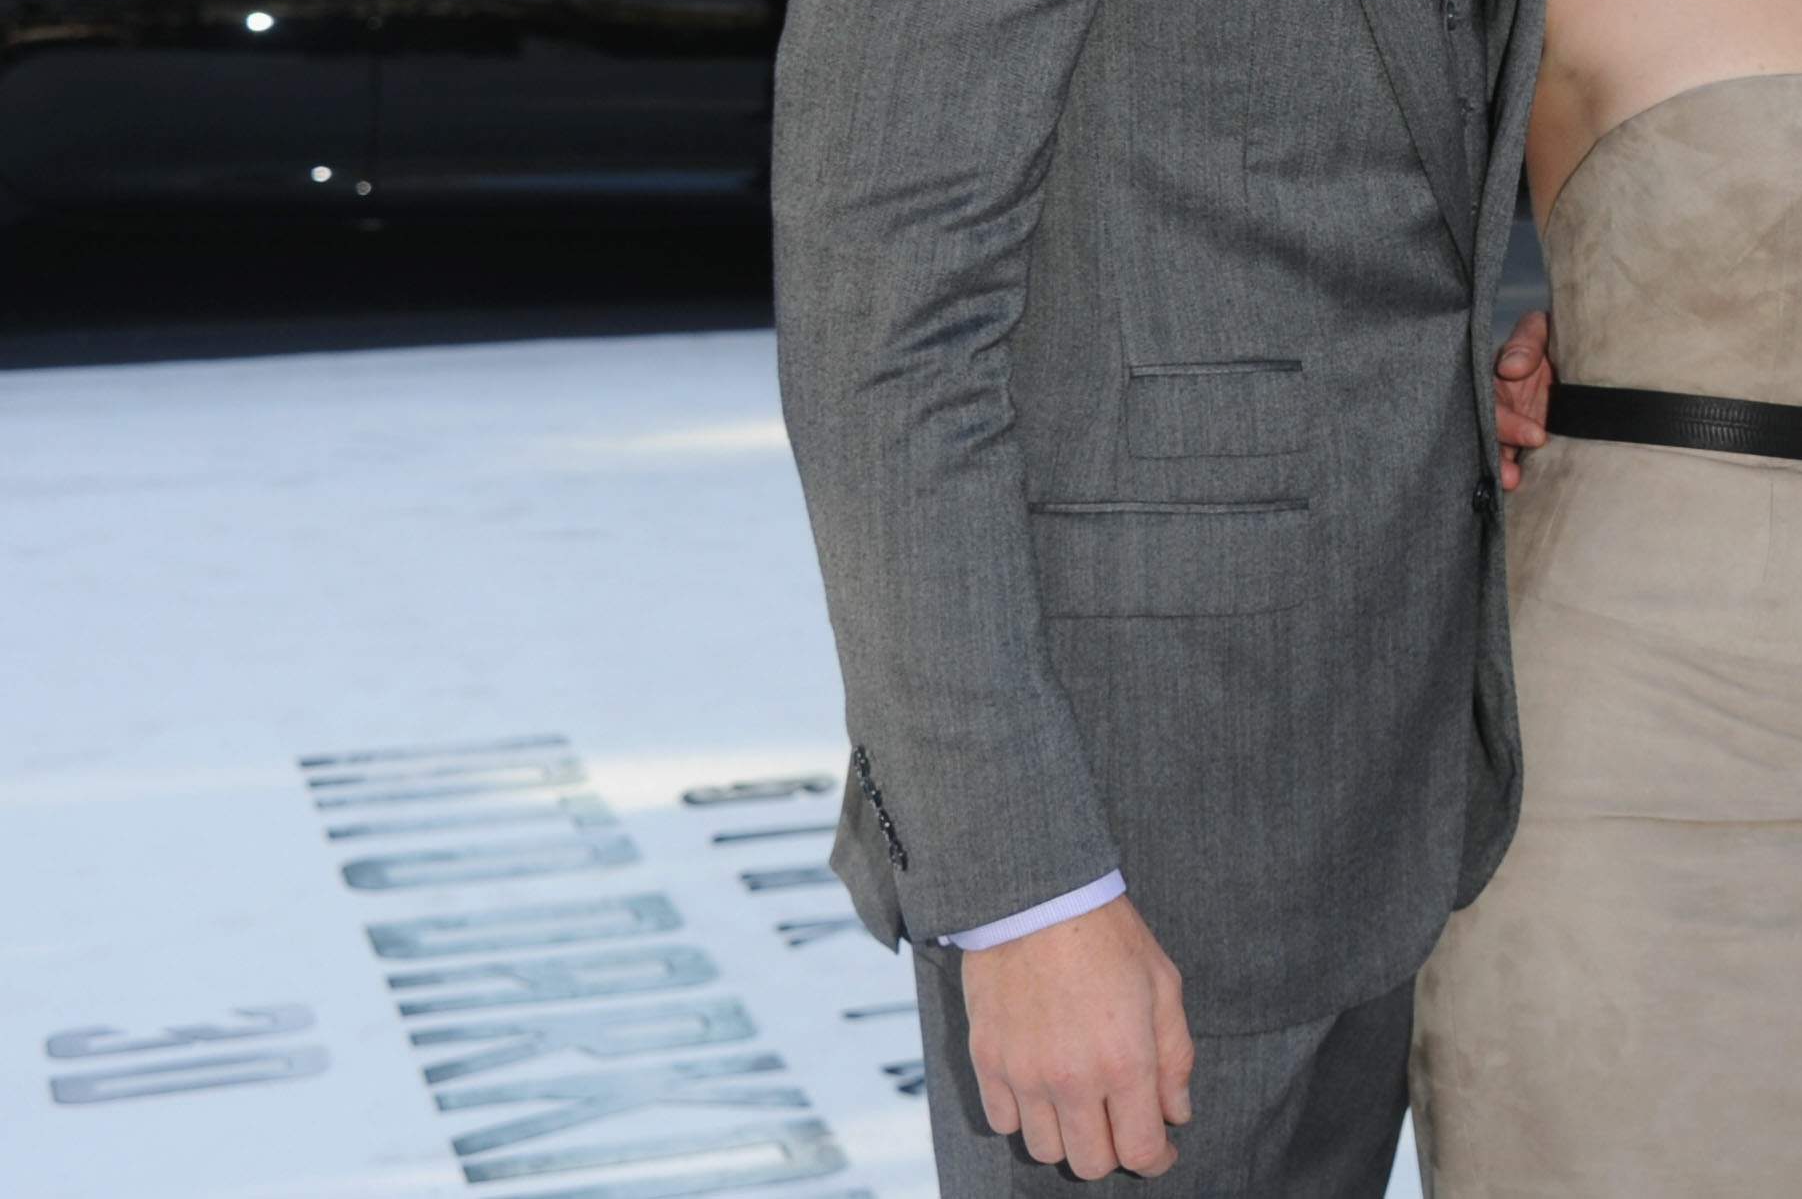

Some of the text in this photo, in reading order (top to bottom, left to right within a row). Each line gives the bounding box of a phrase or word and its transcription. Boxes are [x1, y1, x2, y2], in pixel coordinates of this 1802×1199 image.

[46, 1003, 330, 1105] 3D
[297, 733, 878, 1199] INTO DARKN
